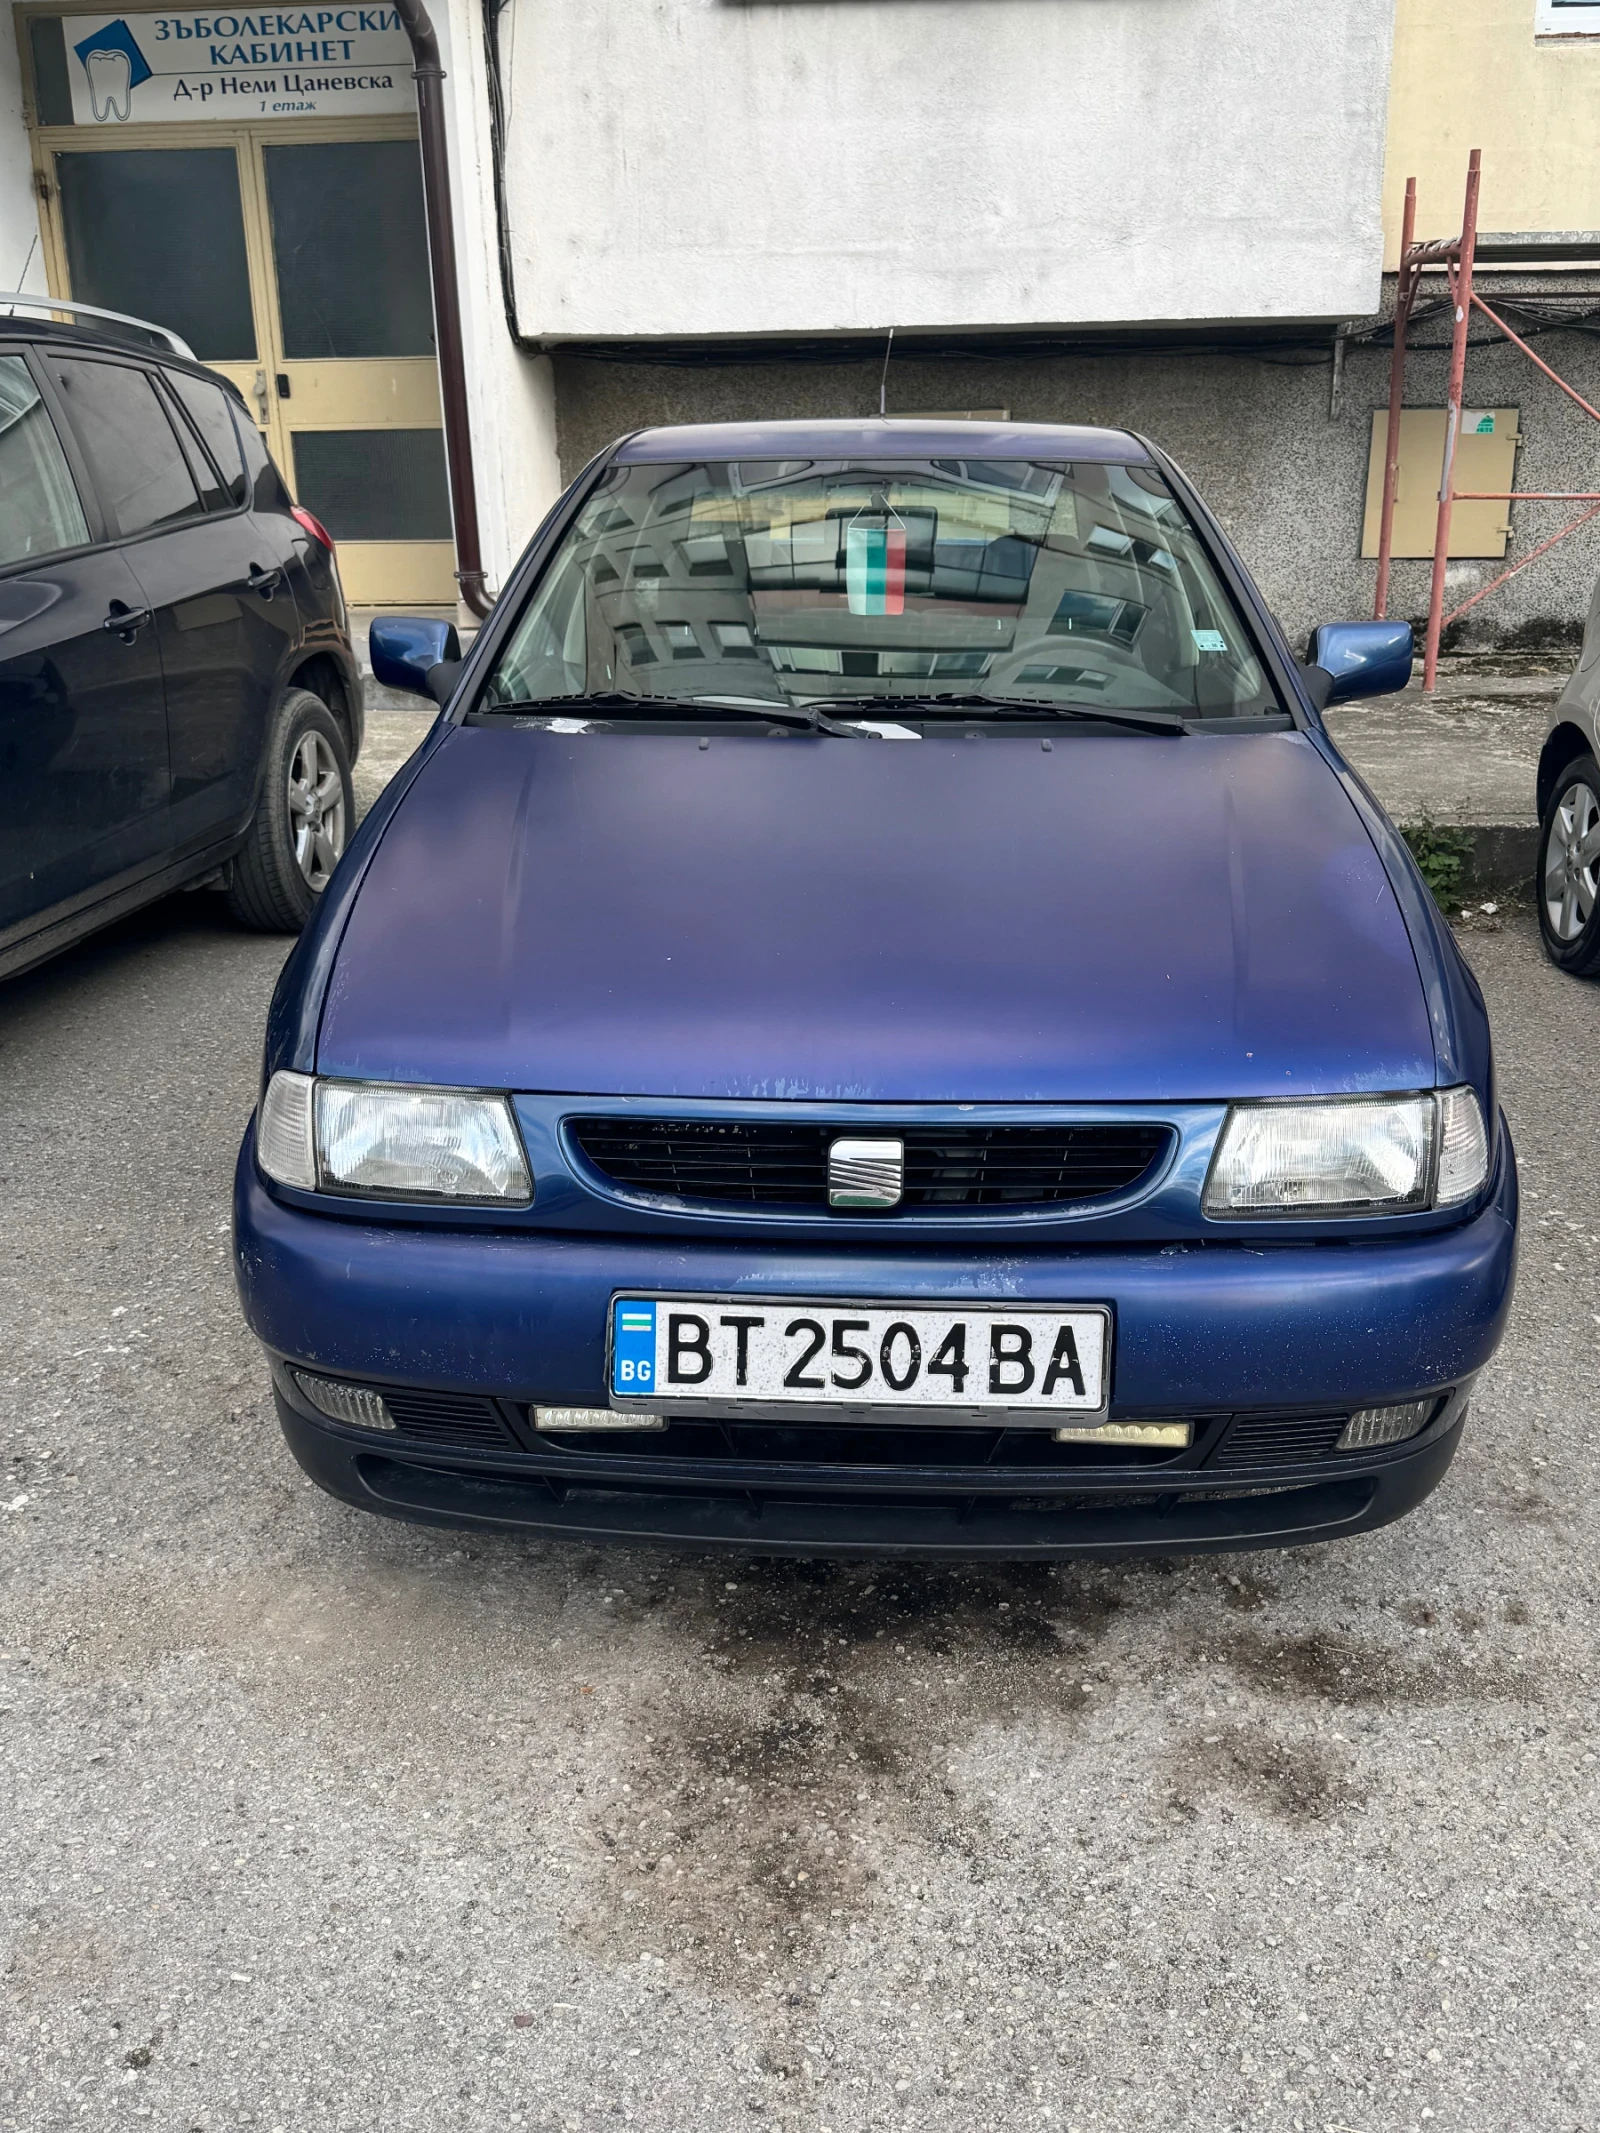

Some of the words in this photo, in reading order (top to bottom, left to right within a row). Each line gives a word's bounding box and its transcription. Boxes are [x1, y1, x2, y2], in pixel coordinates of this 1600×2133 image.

[154, 9, 401, 41] ЗЪБОЛЕКАРСКИ
[209, 39, 355, 66] КАБИНЕТ
[173, 78, 214, 101] Д-р
[221, 77, 276, 95] Нели
[283, 72, 394, 96] Цаневска
[259, 101, 267, 112] 1
[272, 100, 317, 112] етаж
[667, 1313, 765, 1386] BT
[782, 1317, 971, 1394] 2504
[988, 1324, 1087, 1396] BA
[621, 1361, 652, 1382] BG
